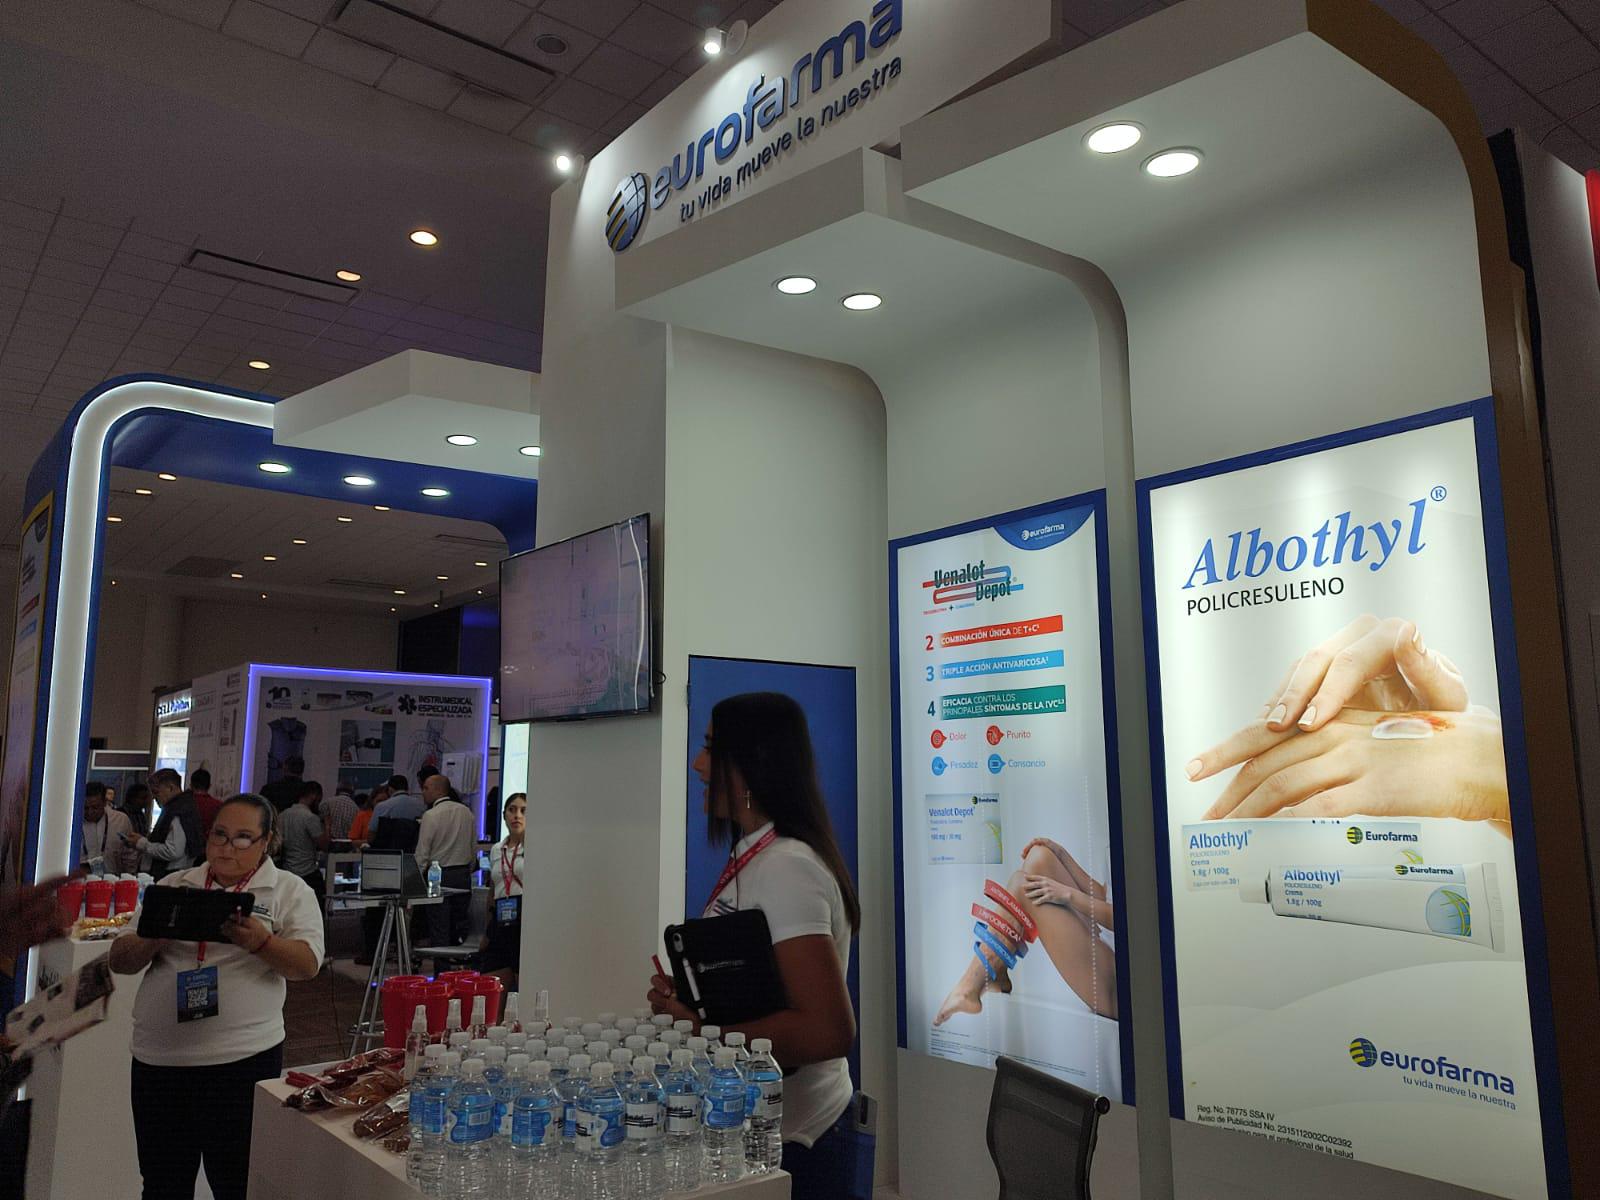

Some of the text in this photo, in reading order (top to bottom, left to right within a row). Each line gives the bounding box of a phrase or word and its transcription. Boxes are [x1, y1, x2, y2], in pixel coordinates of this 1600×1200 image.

[650, 0, 902, 210] eurofarma
[680, 55, 902, 222] tu vida mueve la nuestra
[1030, 523, 1065, 538] eurofarma
[934, 560, 985, 588] Venalot
[1187, 576, 1345, 616] POLICRESULENO
[925, 635, 934, 651] 2
[941, 630, 988, 645] COMBINACIÓN
[989, 627, 1011, 638] ÚNICA
[1012, 626, 1022, 635] DE
[926, 666, 935, 682] 3
[942, 665, 964, 676] TRIPLE
[965, 661, 991, 673] ACCIÓN
[943, 693, 1016, 707] EFICACIA CONTRA LOS
[927, 701, 936, 717] 4
[943, 705, 984, 716] PRINCIPALES
[984, 702, 1021, 713] SÍNTOMAS
[1022, 701, 1033, 710] DE
[1034, 701, 1044, 709] LA
[949, 732, 967, 741] Dolor
[928, 807, 954, 816] Venalot
[1365, 831, 1418, 842] Eurofarma
[1410, 866, 1454, 876] Eurofarma
[1380, 1050, 1515, 1096] eurofarma
[1403, 1075, 1517, 1111] tu vida mueve la nuestra
[1213, 1105, 1225, 1114] No.
[1249, 1109, 1265, 1119] SSA
[1267, 1113, 1276, 1121] IV
[1197, 1114, 1215, 1122] Aviso
[1216, 1115, 1225, 1123] de
[1226, 1117, 1263, 1129] Publicidad
[1263, 1122, 1276, 1131] No.
[1314, 1143, 1324, 1152] de
[1325, 1145, 1332, 1154] la
